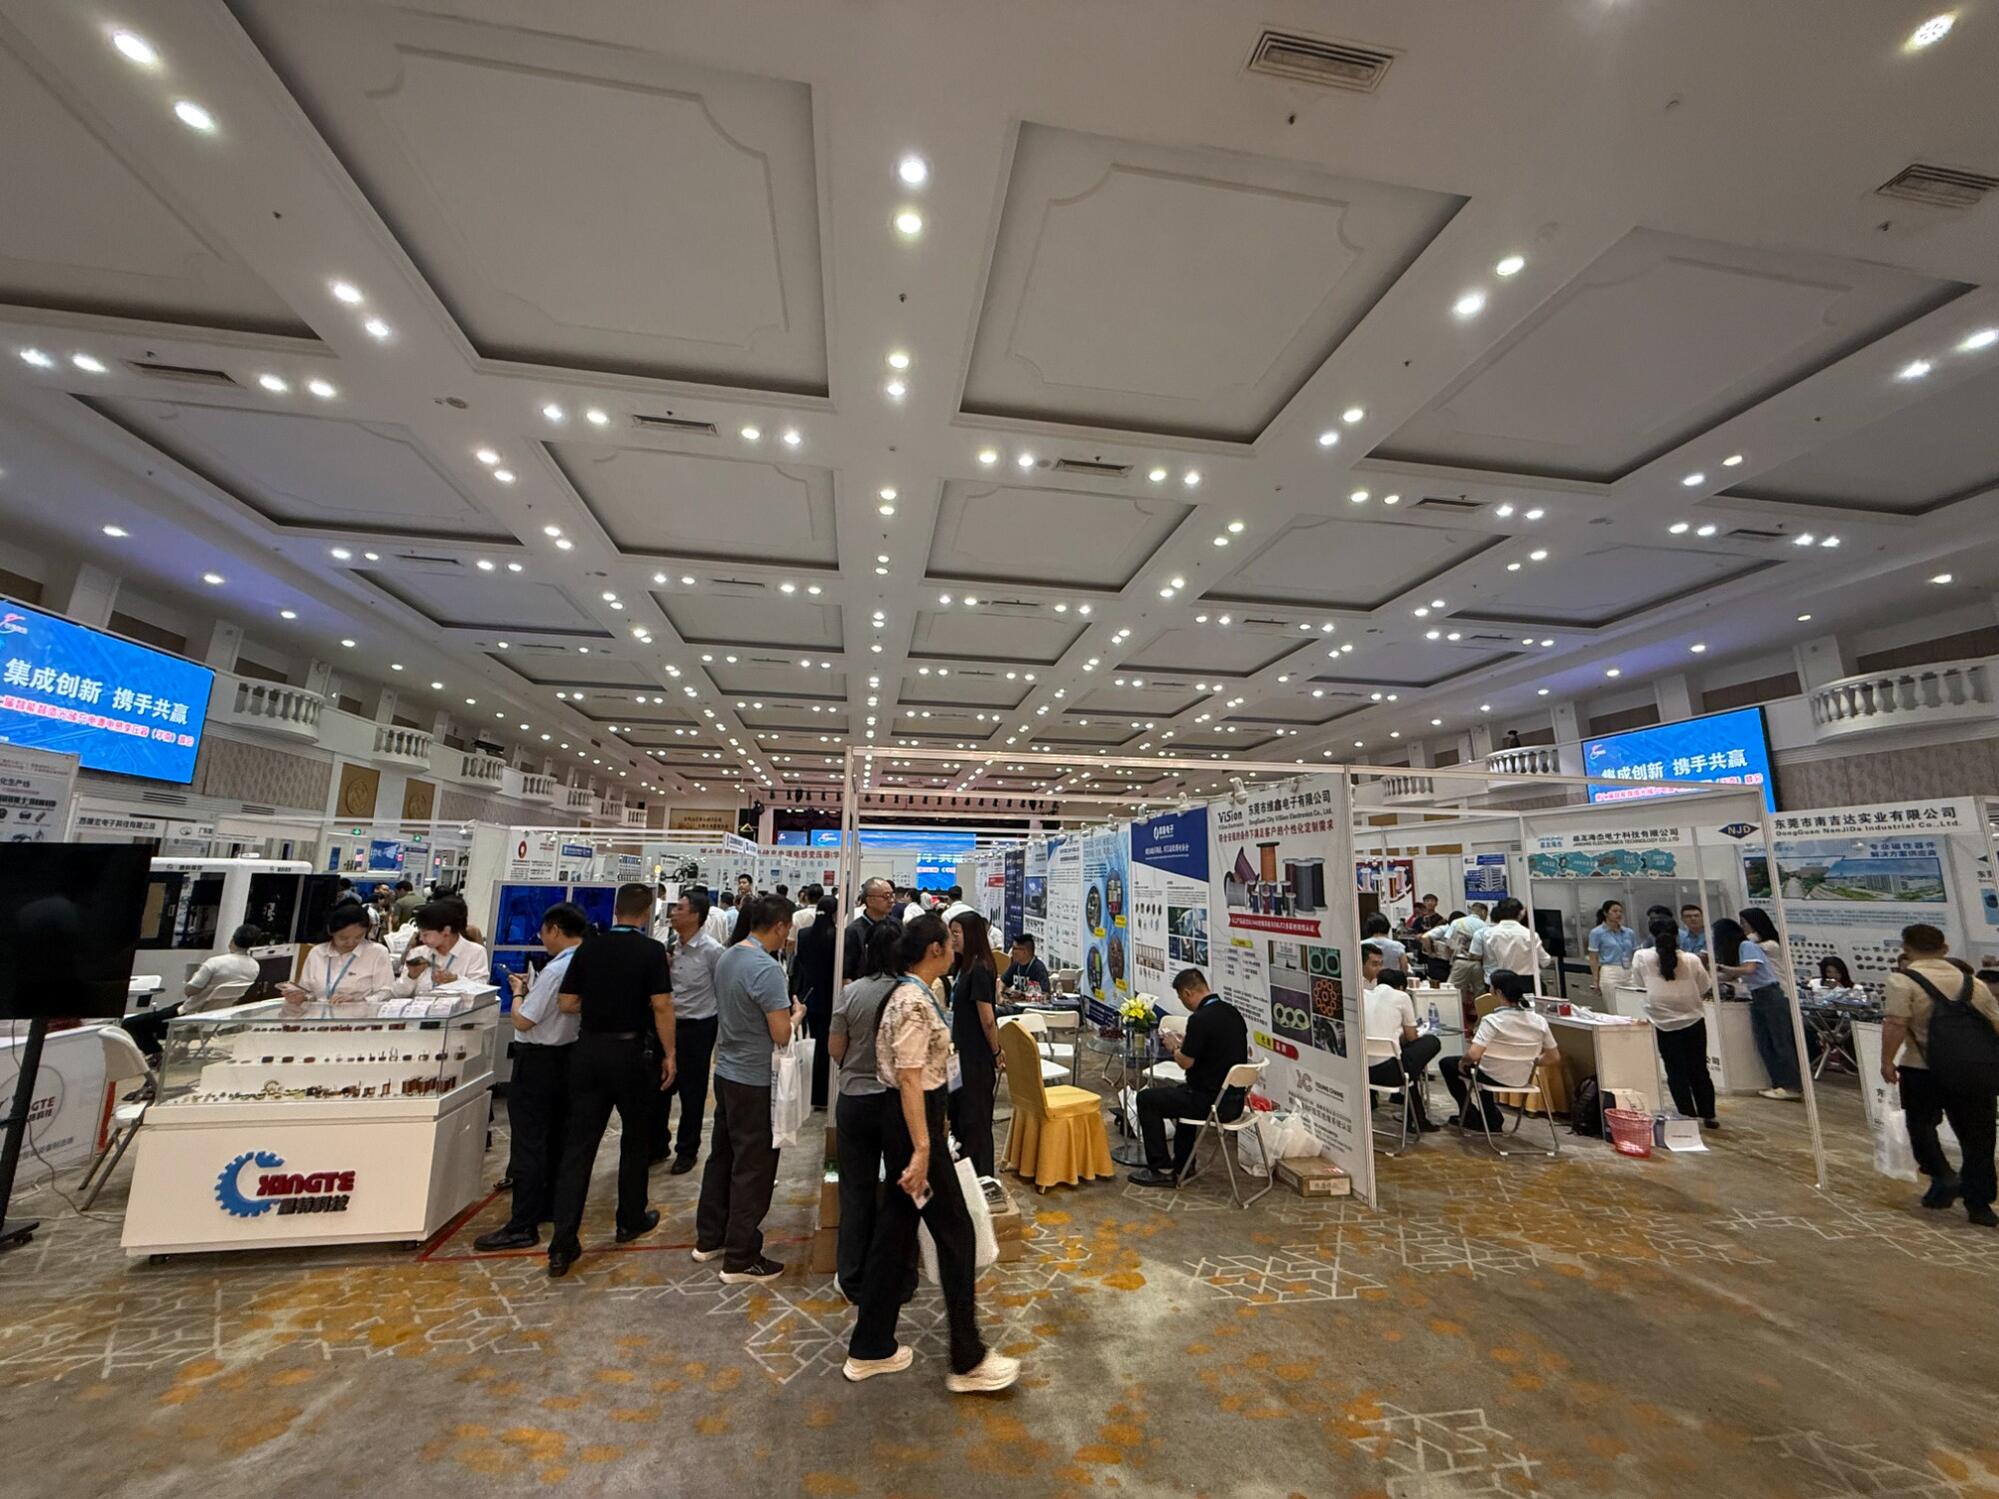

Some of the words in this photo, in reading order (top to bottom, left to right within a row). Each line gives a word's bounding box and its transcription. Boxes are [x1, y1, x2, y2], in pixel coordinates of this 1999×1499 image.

[3, 657, 103, 704] 集成创新
[112, 687, 190, 725] 携手共赢
[1672, 749, 1748, 776] 携手共赢
[1248, 789, 1331, 816] 东莞市维鑫电子有限公司
[1218, 809, 1243, 823] ViSion
[1775, 806, 1957, 829] 东莞市南吉达实业有限公司
[1727, 825, 1751, 835] NJD
[1776, 829, 1820, 837] DongGuan
[1865, 822, 1915, 831] Industrial
[1870, 842, 1936, 850] 专业磁性器件
